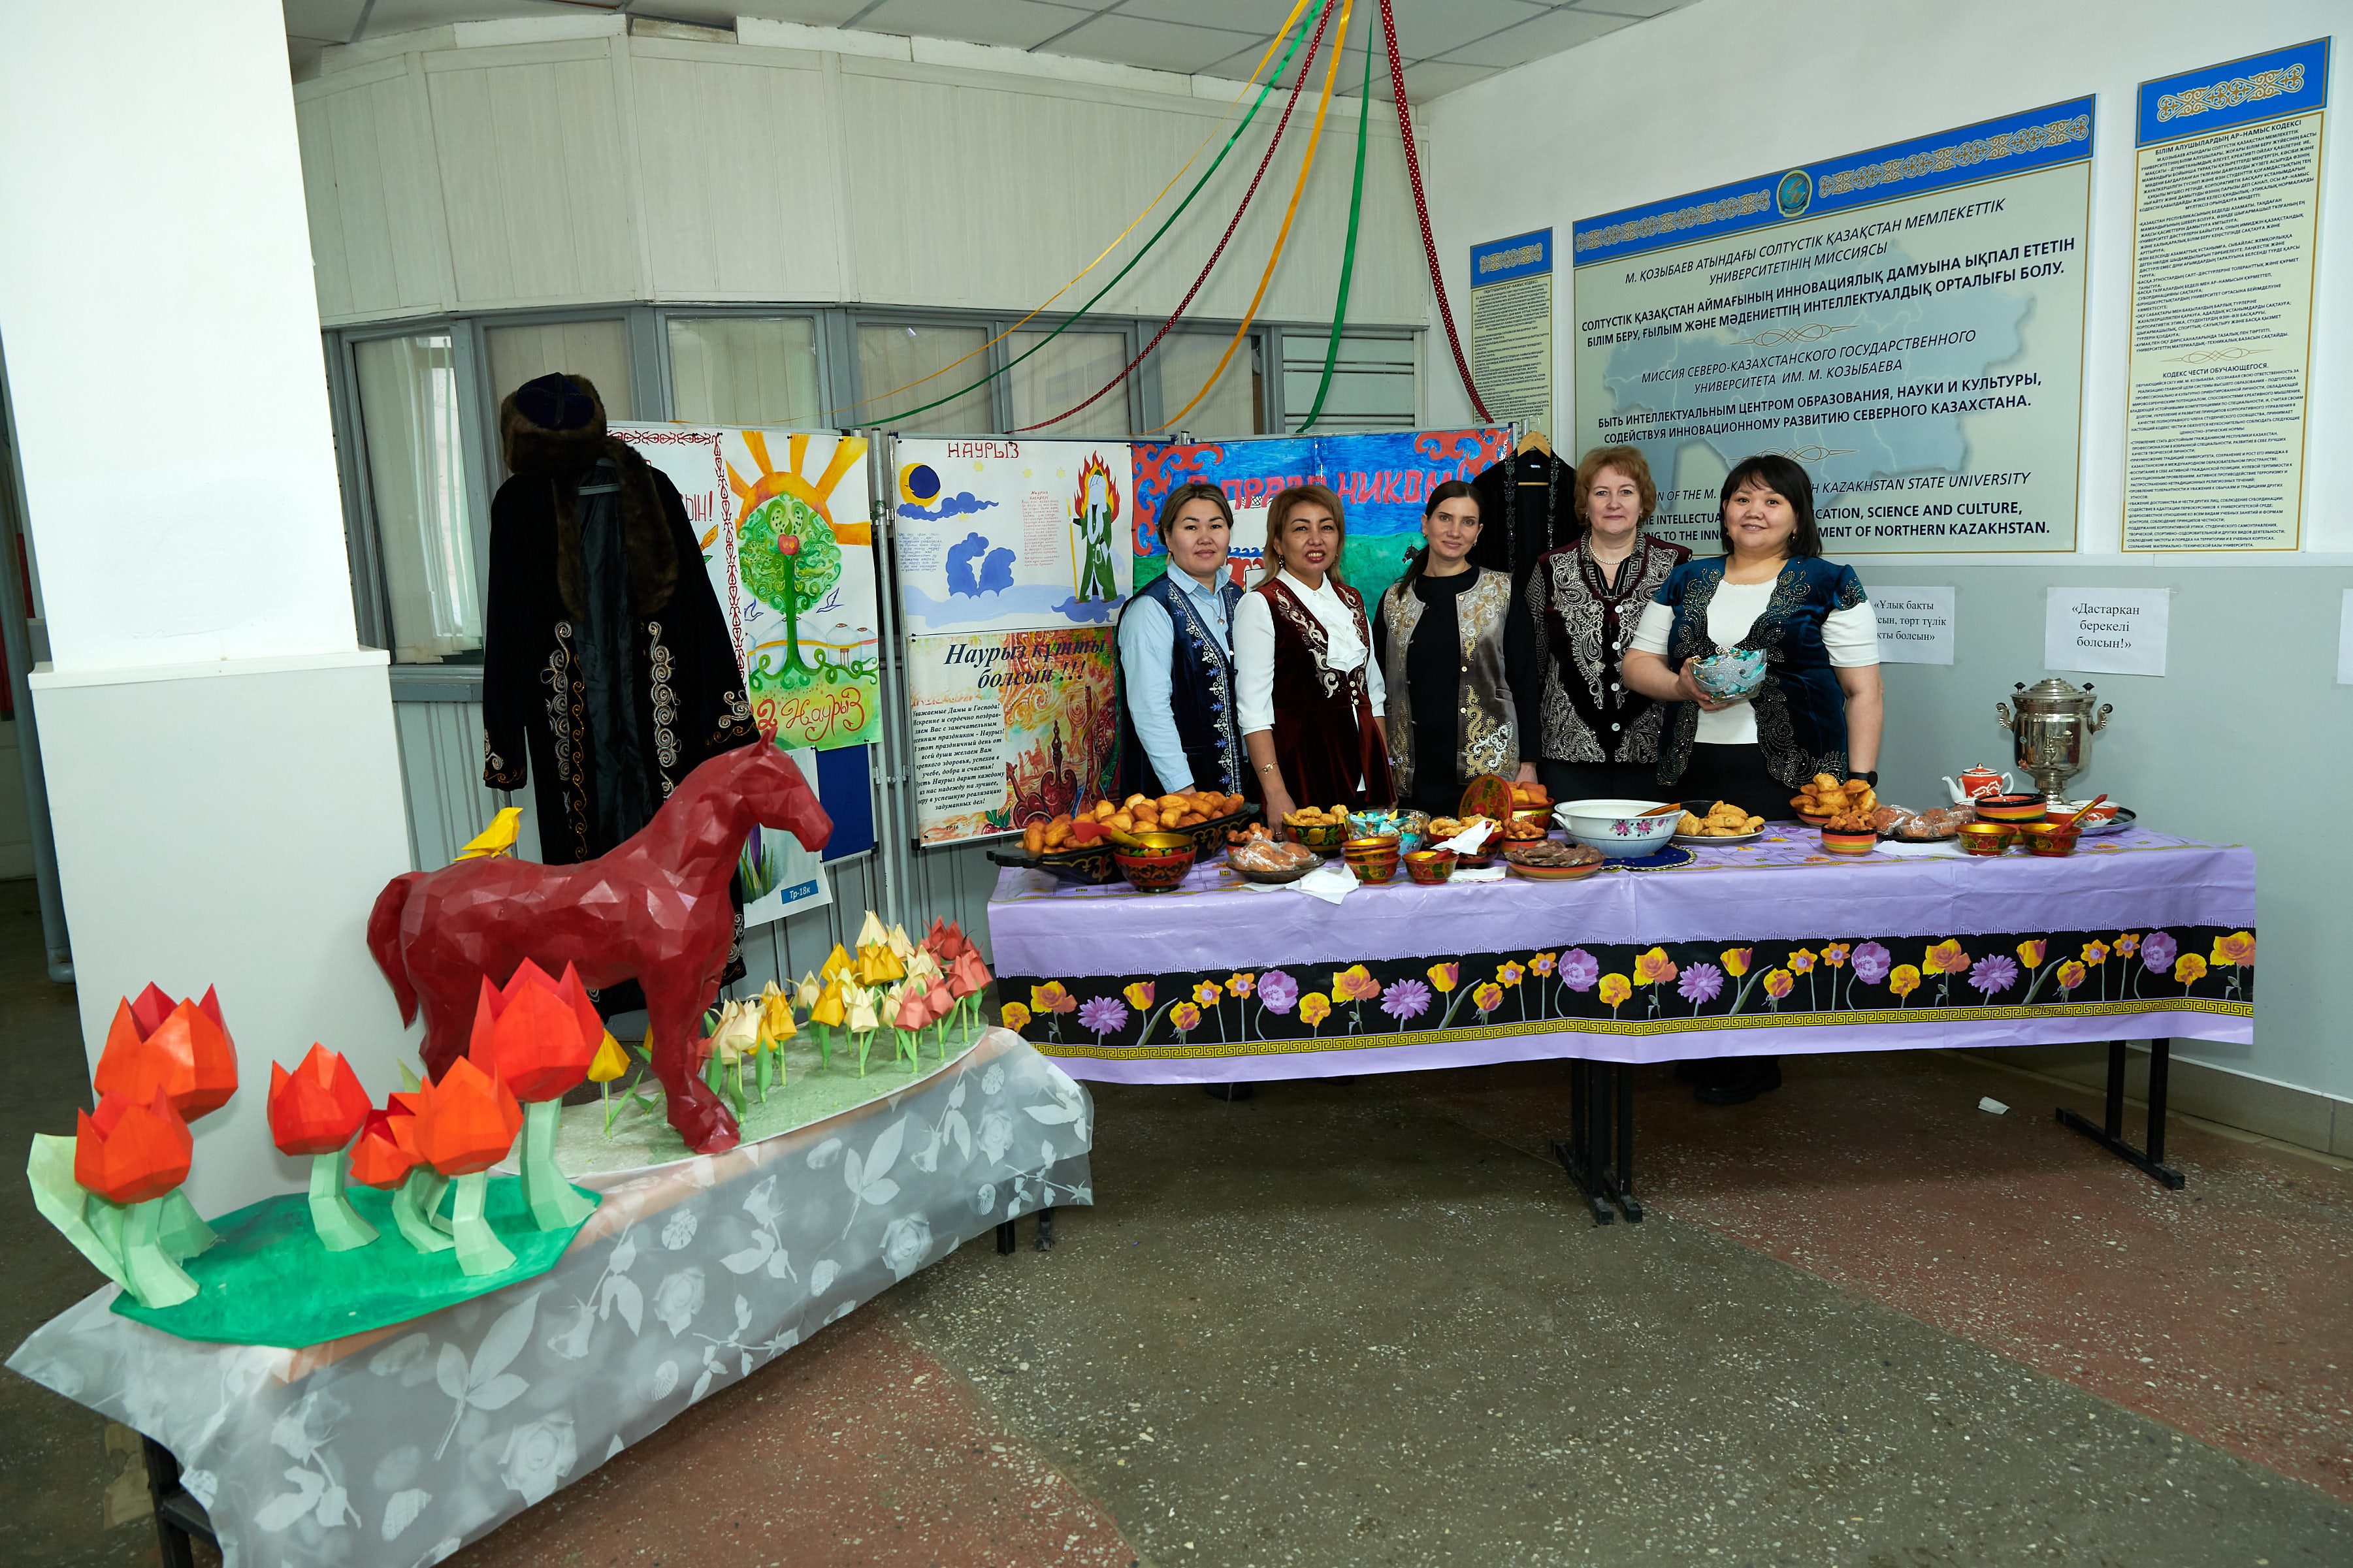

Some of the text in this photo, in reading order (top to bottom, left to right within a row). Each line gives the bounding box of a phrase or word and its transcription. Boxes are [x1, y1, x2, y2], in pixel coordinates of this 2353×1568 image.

[2155, 120, 2301, 155] БІЛІМ АЛУШЫЛАРДЫҢ АР-НАМЫС КОДЕКСІ
[1625, 198, 2005, 283] М. ҚОЗЫБАЕВ АТЫНДАҒЫ СОЛТҮСТІК ҚАЗАҚСТАН МЕМЛЕКЕТТІК
[1710, 242, 1887, 285] УНИВЕРСИТЕТІНІҢ МИССИЯСЫ
[1582, 238, 2074, 331] СОЛТҮСТІК ҚАЗАҚСТАН АЙМАҒЫНЫҢ ИННОВАЦИЯЛЫҚ ДАМУЫНА ЫҚПАЛ ЕТЕТІН
[1587, 261, 2064, 347] БІЛІМ БЕРУ, ҒЫЛЫМ ЖӘНЕ МӘДЕНИЕТТІҢ ИНТЕЛЛЕКТУАЛДЫҚ ОРТАЛЫҒЫ БОЛУ.
[1642, 330, 1976, 383] МИССИЯ СЕВЕРО-КАЗАХСТАНСКОГО ГОСУДАРСТВЕННОГО
[2210, 362, 2269, 374] ОБУЧАЮЩЕГОСЯ.
[1694, 359, 1902, 394] УНИВЕРСИТЕТА ИМ. М. КОЗЫБАЕВА
[1598, 372, 2041, 428] БЫТЬ ИНТЕЛЛЕКТУАЛЬНЫМ ЦЕНТРОМ ОБРАЗОВАНИЯ, НАУКИ И КУЛЬТУРЫ,
[1604, 395, 2031, 444] СОДЕЙСТВУЯ ИННОВАЦИОННОМУ РАЗВИТИЮ СЕВЕРНОГО КАЗАХСТАНА.
[947, 442, 1019, 458] НАУРЫЗ
[1823, 479, 1905, 493] KAZAKHSTAN
[1907, 477, 1945, 489] STATE
[1949, 472, 2031, 487] UNIVERSITY
[1667, 490, 1680, 501] OF
[1683, 489, 1702, 500] THE
[1704, 488, 1716, 499] M.
[1657, 511, 1723, 524] INTELLECTUA
[1813, 502, 2022, 522] CATION, SCIENCE AND CULTURE,
[1663, 531, 1676, 541] TO
[1679, 530, 1698, 541] THE
[1855, 526, 1871, 537] OF
[1875, 524, 1945, 536] NORTHERN
[1949, 521, 2049, 535] KAZAKHSTAN.
[1874, 600, 1934, 610] «Ұлық бақты
[2072, 603, 2139, 616] «Дастарқан
[1900, 618, 1920, 627] төрт
[1922, 616, 1946, 628] түлік
[2080, 620, 2129, 633] берекелі
[1896, 631, 1935, 641] болсын»
[2077, 636, 2131, 648] болсын!»
[943, 643, 1026, 667] Наурыз
[977, 668, 1052, 688] болсын
[973, 703, 1000, 711] Господа!
[948, 722, 997, 731] замечательным
[938, 733, 974, 742] праздником
[980, 728, 1005, 737] Наурыз!
[935, 740, 977, 750] праздничный
[922, 770, 941, 778] учебе,
[967, 763, 994, 772] счастья!
[934, 793, 965, 803] успешную
[966, 789, 1001, 799] реализацию
[935, 801, 971, 810] задуманных
